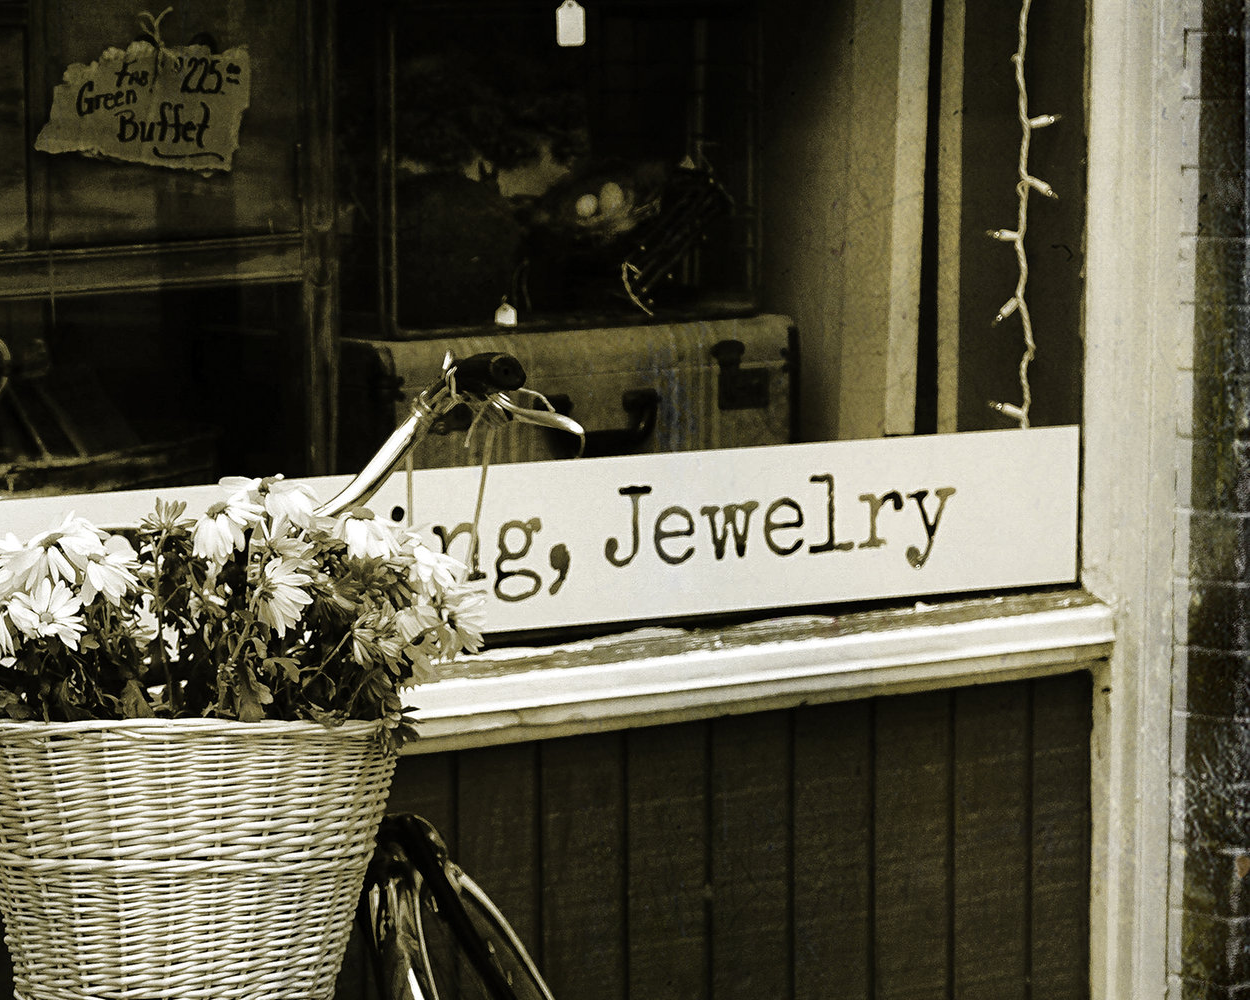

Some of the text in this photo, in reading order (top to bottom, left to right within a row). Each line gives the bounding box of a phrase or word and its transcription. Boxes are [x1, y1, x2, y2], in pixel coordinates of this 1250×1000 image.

[75, 80, 138, 117] Green
[114, 101, 211, 149] Buffet
[604, 473, 956, 569] Jewelry
